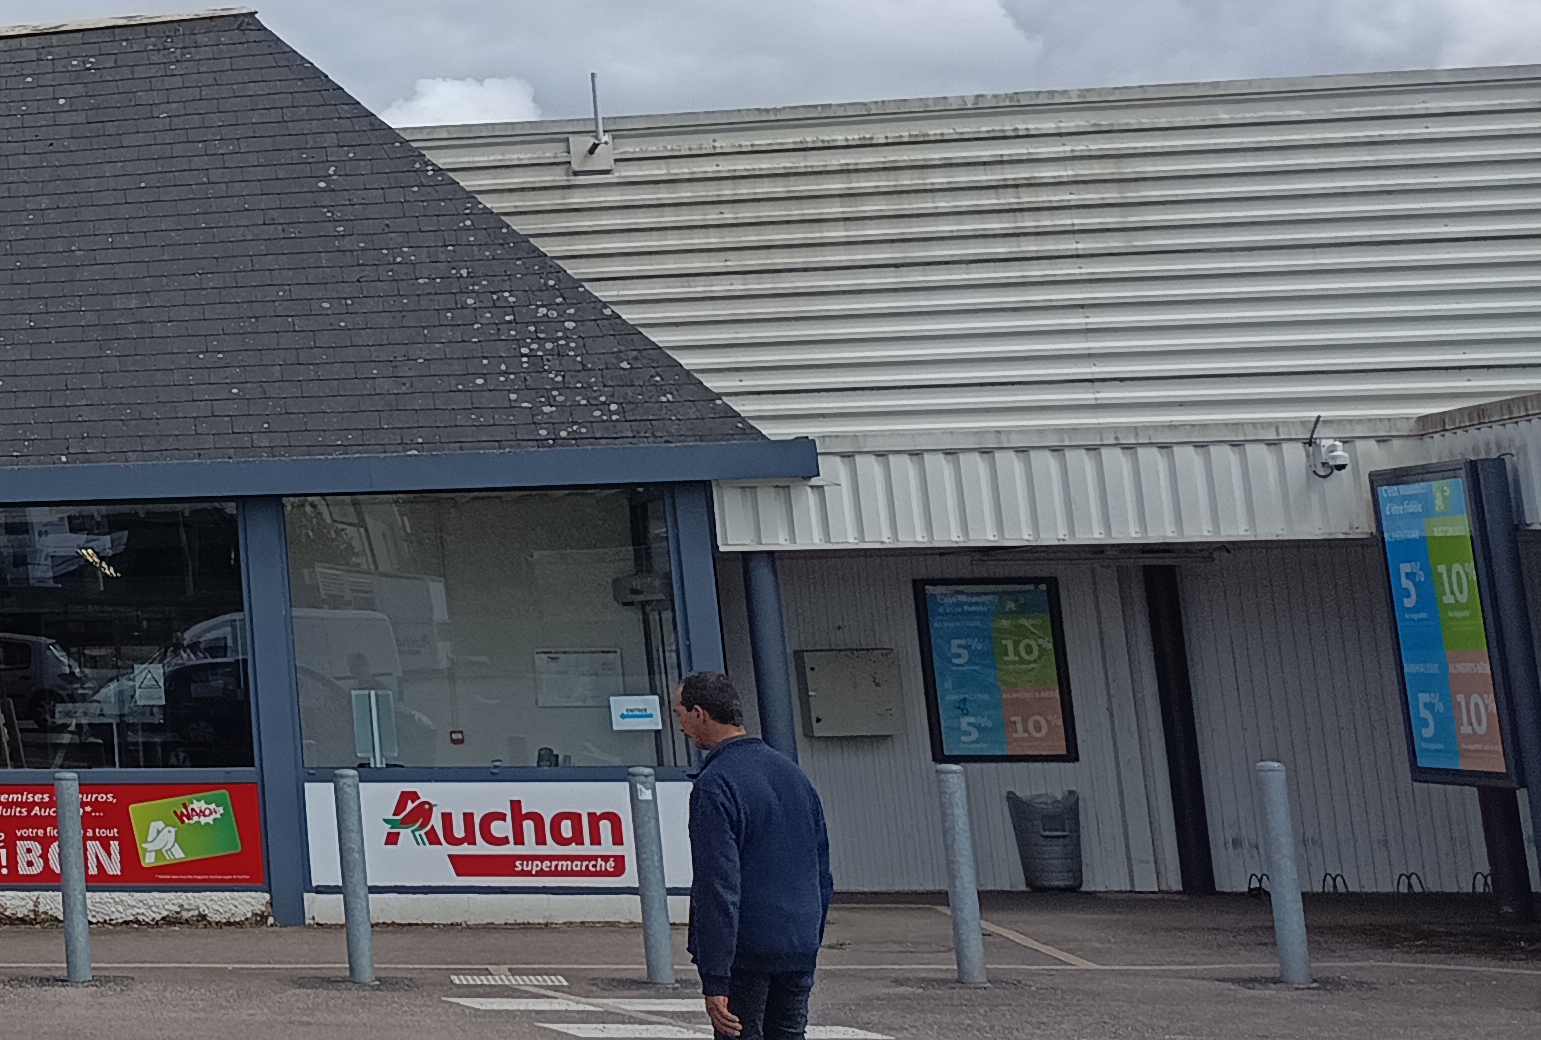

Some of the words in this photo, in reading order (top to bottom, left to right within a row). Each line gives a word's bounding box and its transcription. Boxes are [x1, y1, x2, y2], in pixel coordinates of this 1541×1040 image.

[382, 790, 624, 846] Auchan
[15, 828, 44, 837] votre
[95, 827, 119, 837] tout
[514, 857, 615, 874] supermarché
